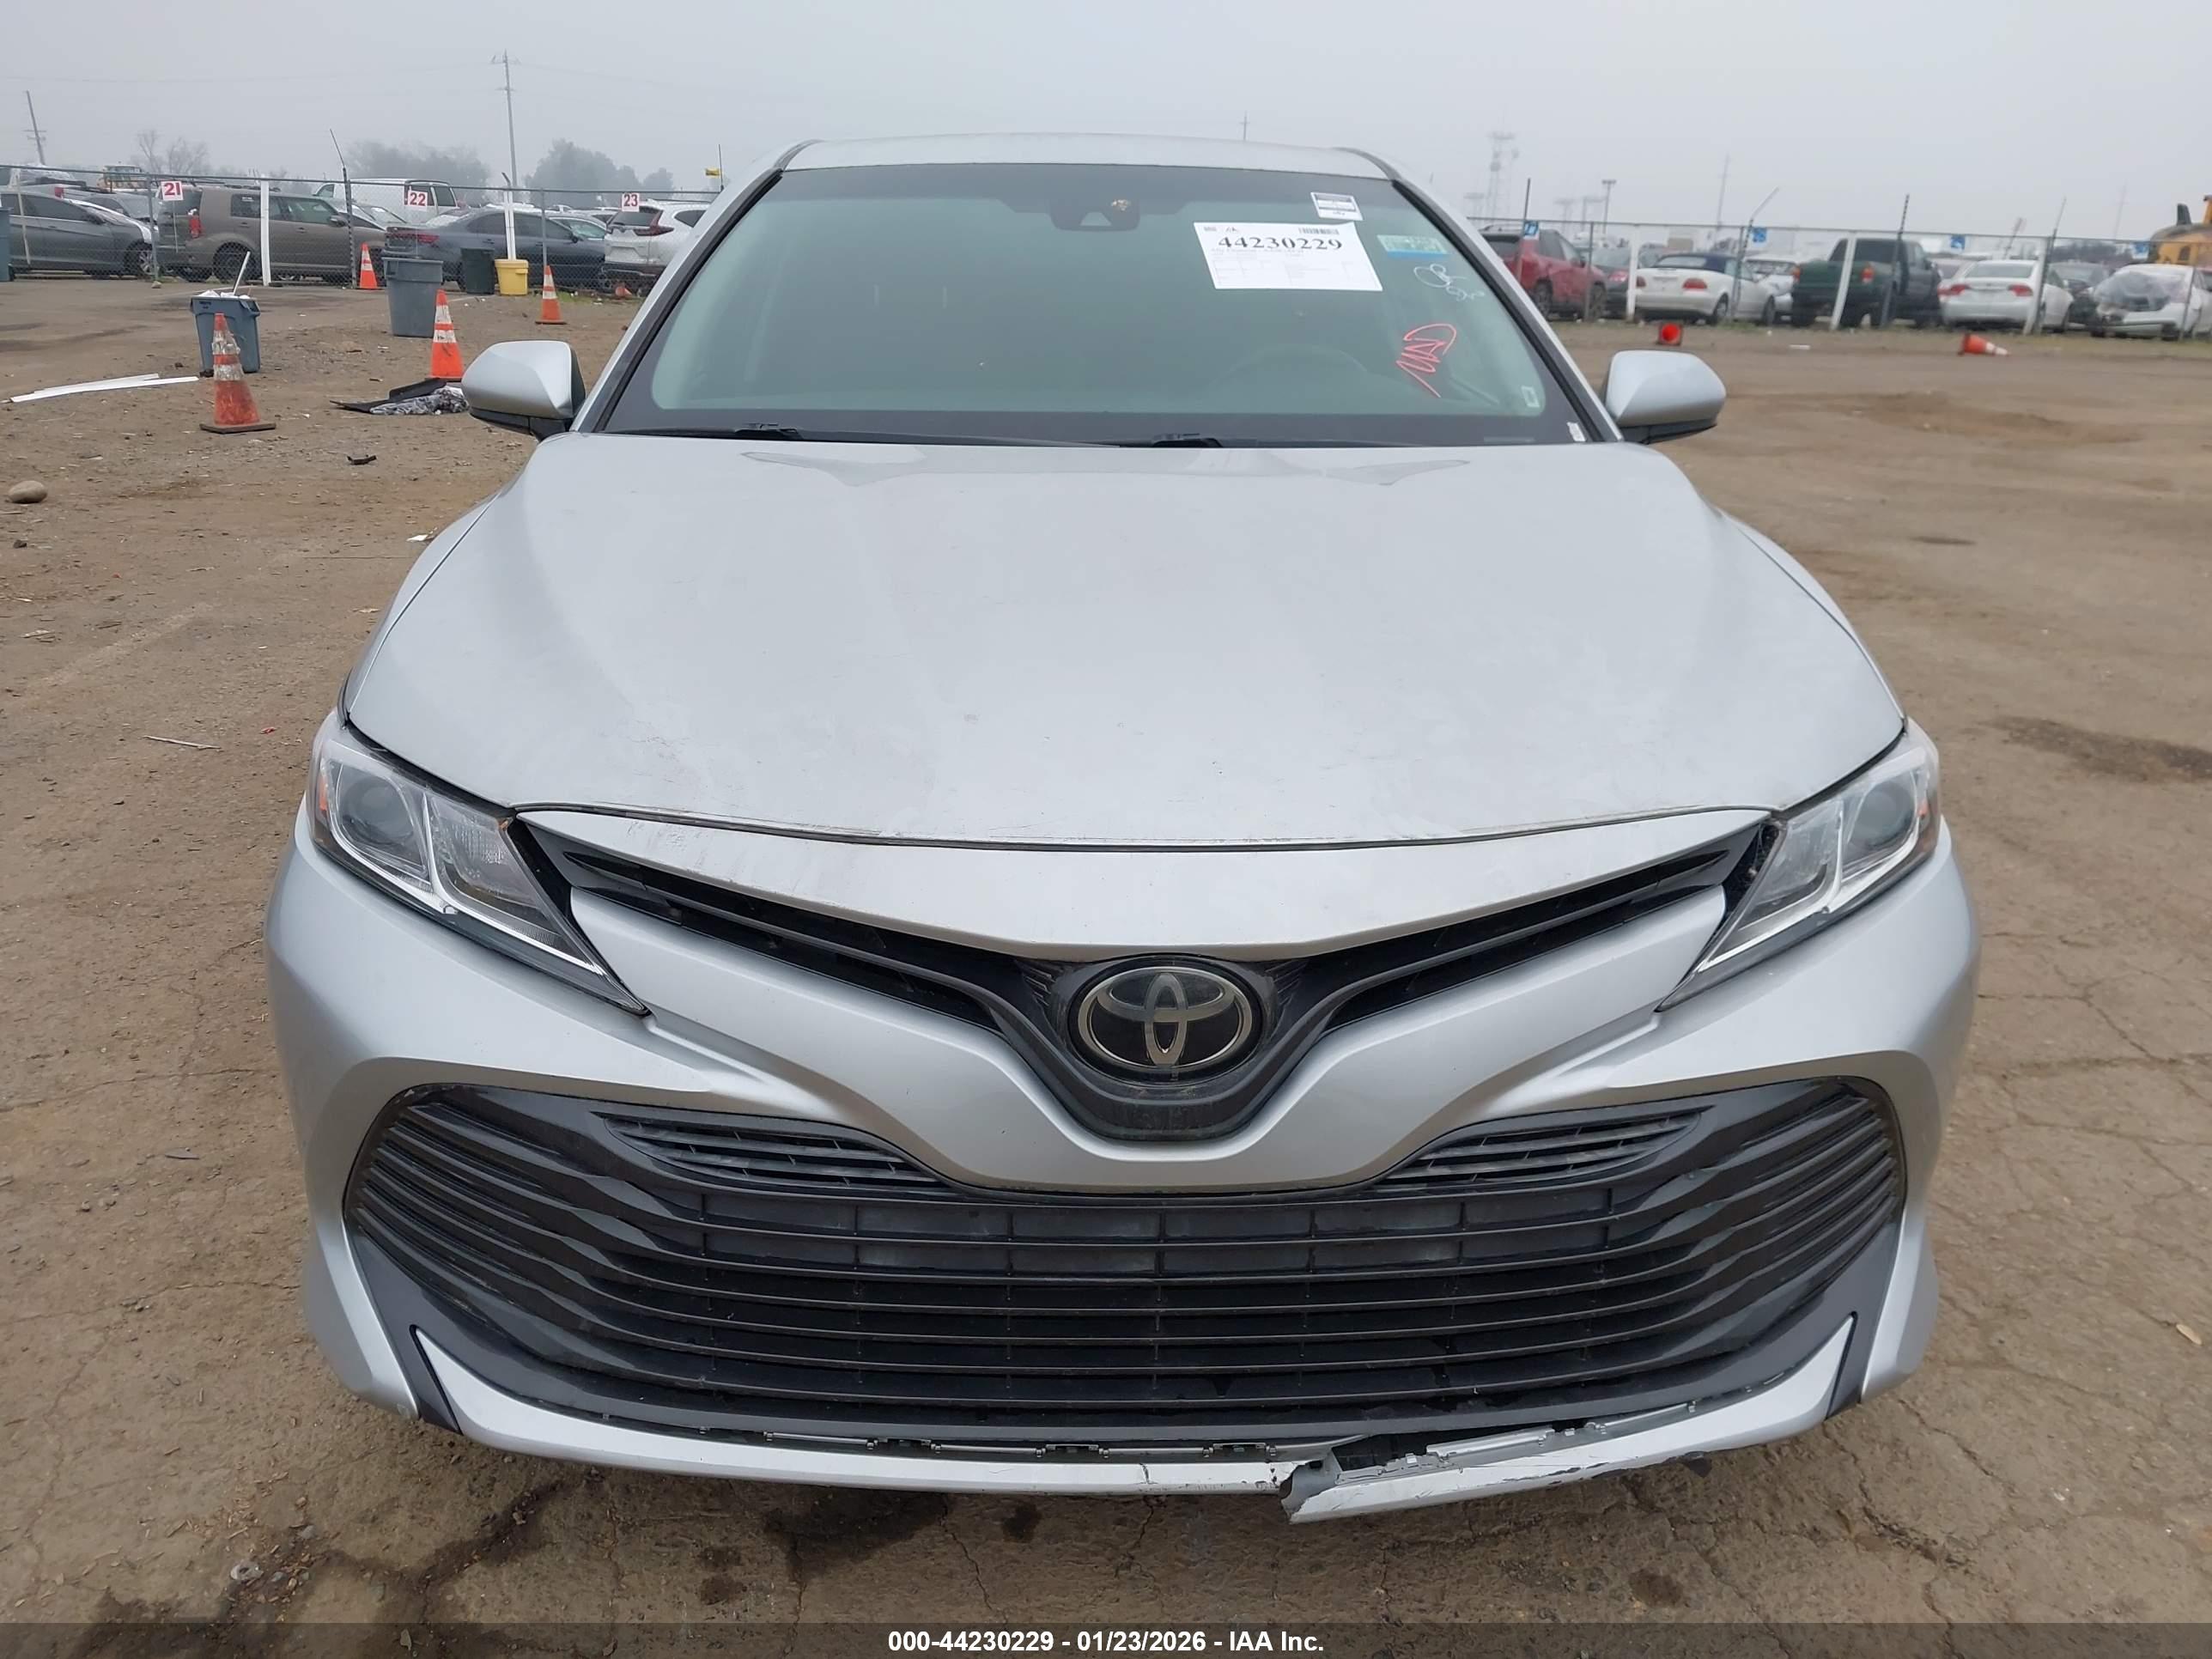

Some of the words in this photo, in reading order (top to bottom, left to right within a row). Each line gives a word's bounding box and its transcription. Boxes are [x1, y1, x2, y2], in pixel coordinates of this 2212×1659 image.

[164, 182, 180, 196] 21
[410, 192, 426, 206] 22
[623, 193, 638, 207] 23
[1218, 236, 1343, 251] 44230229
